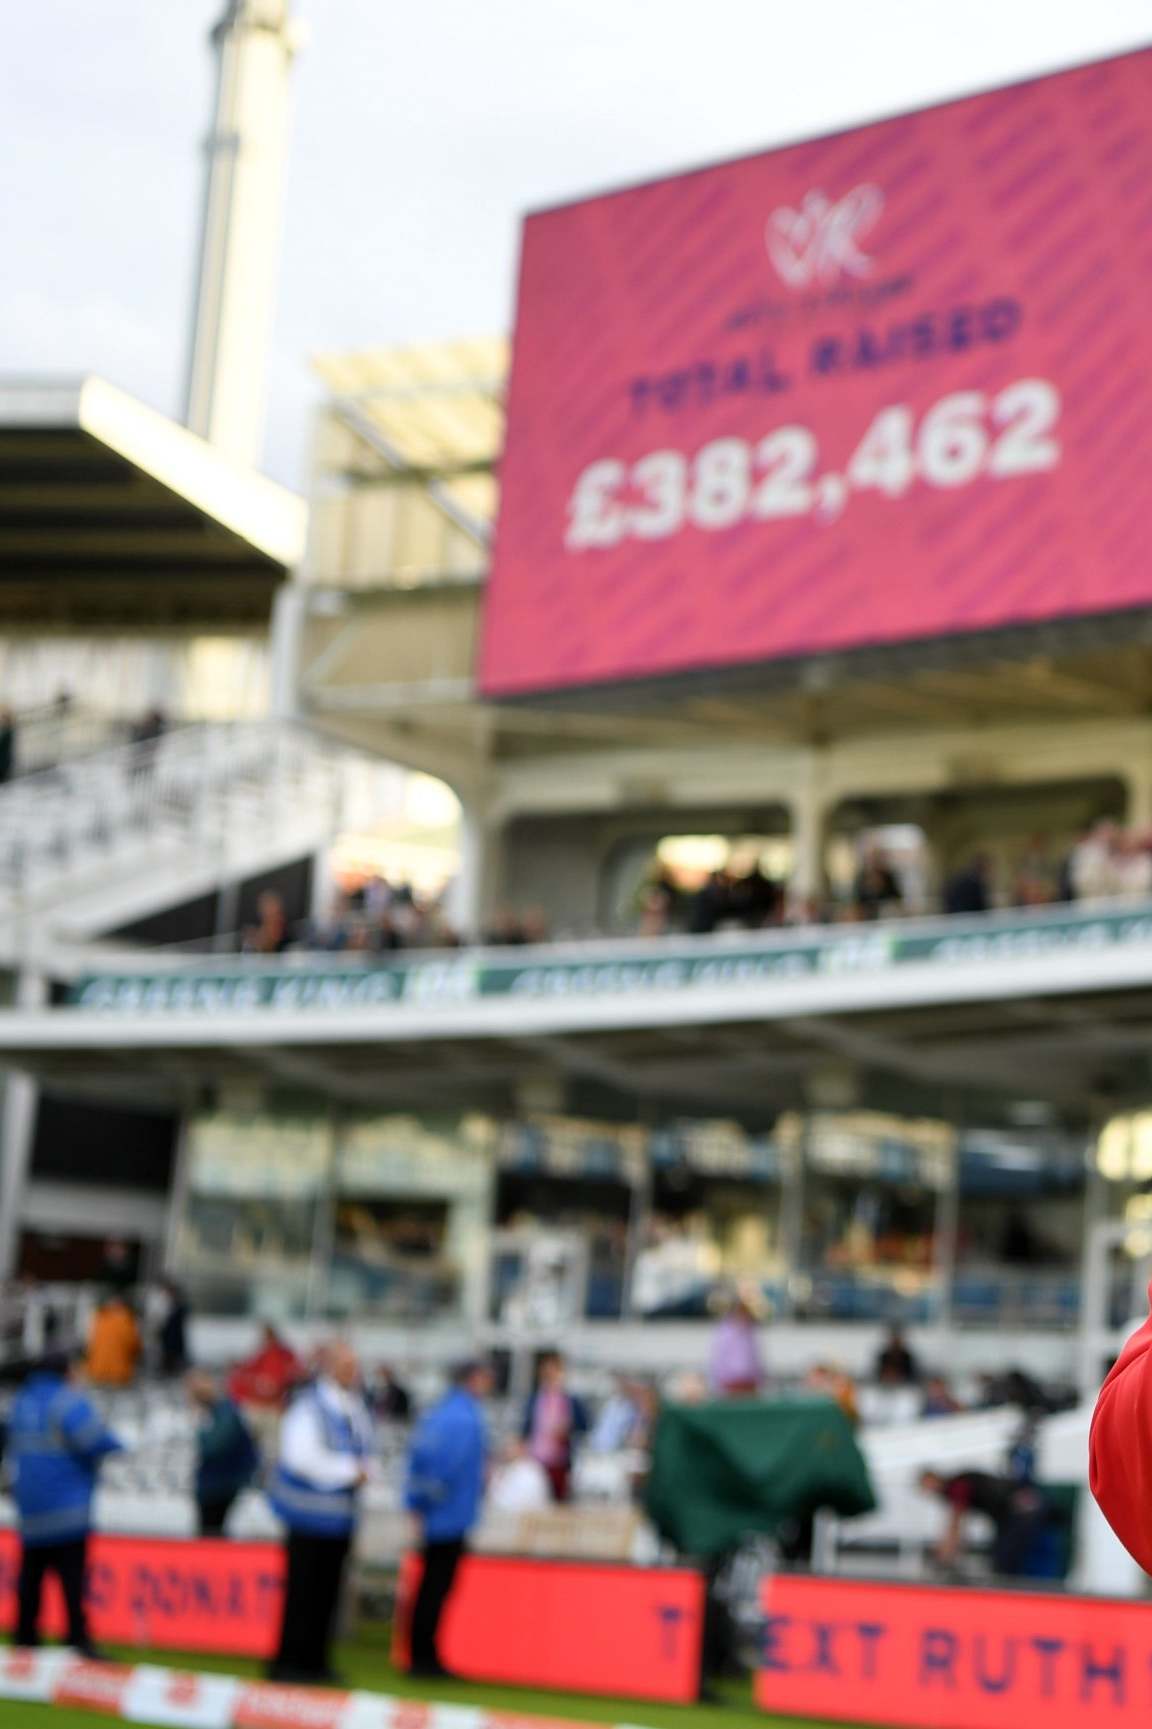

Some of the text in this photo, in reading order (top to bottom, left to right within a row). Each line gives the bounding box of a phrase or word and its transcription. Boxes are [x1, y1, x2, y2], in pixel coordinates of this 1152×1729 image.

[630, 350, 790, 413] TOTAL
[812, 298, 1021, 376] RAISED
[565, 379, 1060, 550] £382,462
[130, 1563, 284, 1620] DONAT
